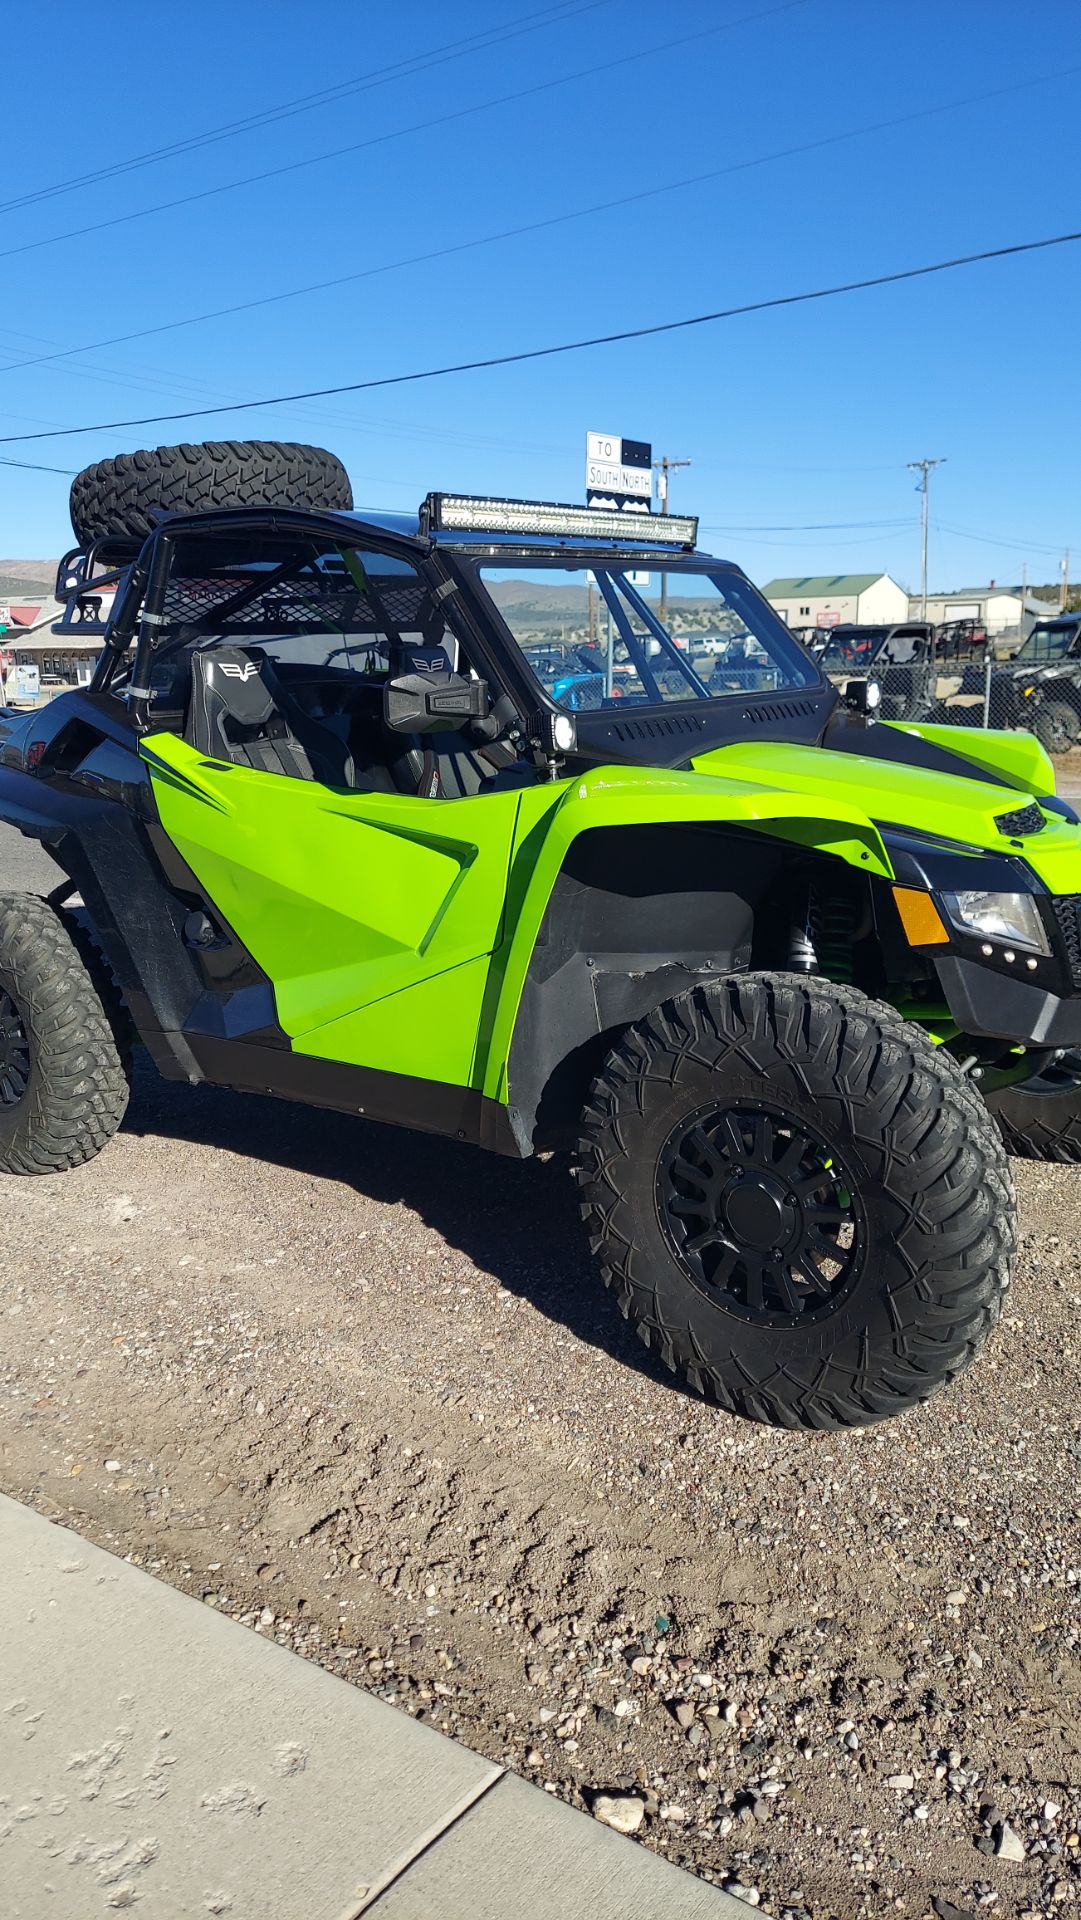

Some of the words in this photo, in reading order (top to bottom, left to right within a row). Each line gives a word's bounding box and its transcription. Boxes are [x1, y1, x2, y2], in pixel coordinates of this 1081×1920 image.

[597, 441, 612, 457] TO
[590, 466, 618, 485] SOUTH
[622, 471, 650, 491] NORTH
